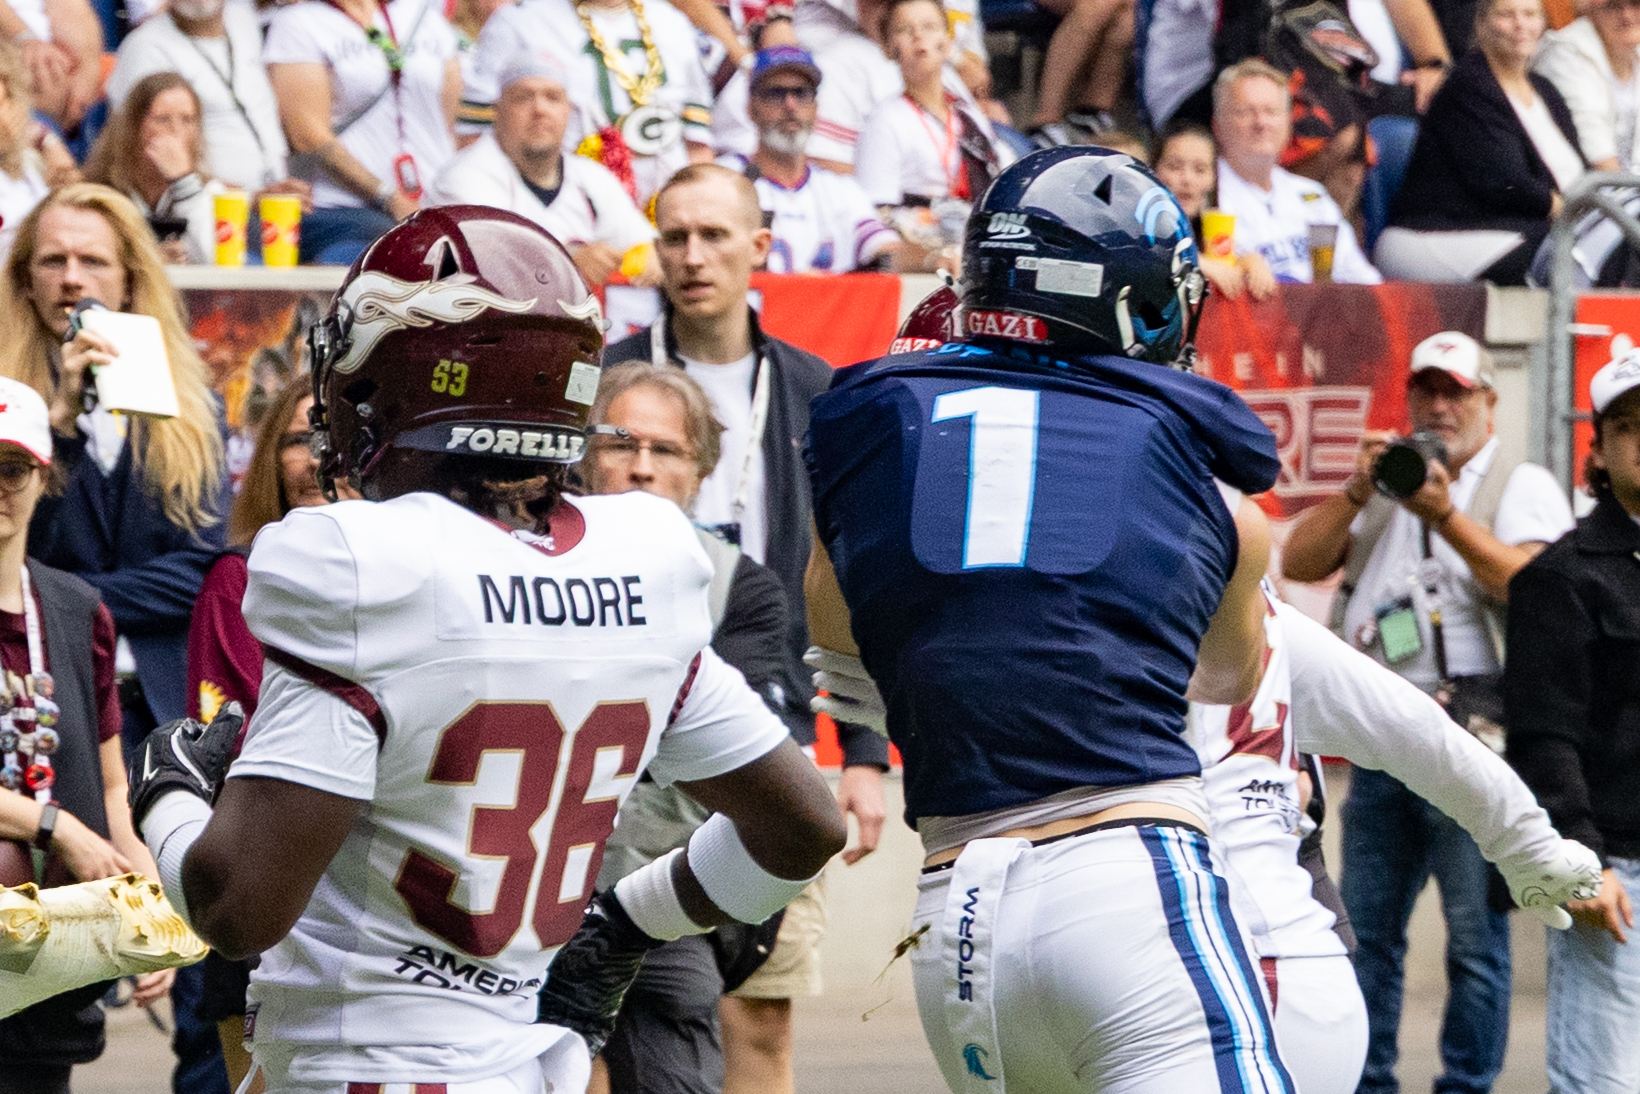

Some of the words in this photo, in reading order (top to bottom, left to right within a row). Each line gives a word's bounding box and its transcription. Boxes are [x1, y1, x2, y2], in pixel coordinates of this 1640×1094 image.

[430, 359, 469, 397] 53
[931, 386, 1041, 570] 1
[477, 574, 647, 627] MOORE
[393, 698, 652, 961] 36
[958, 886, 980, 1003] STORM
